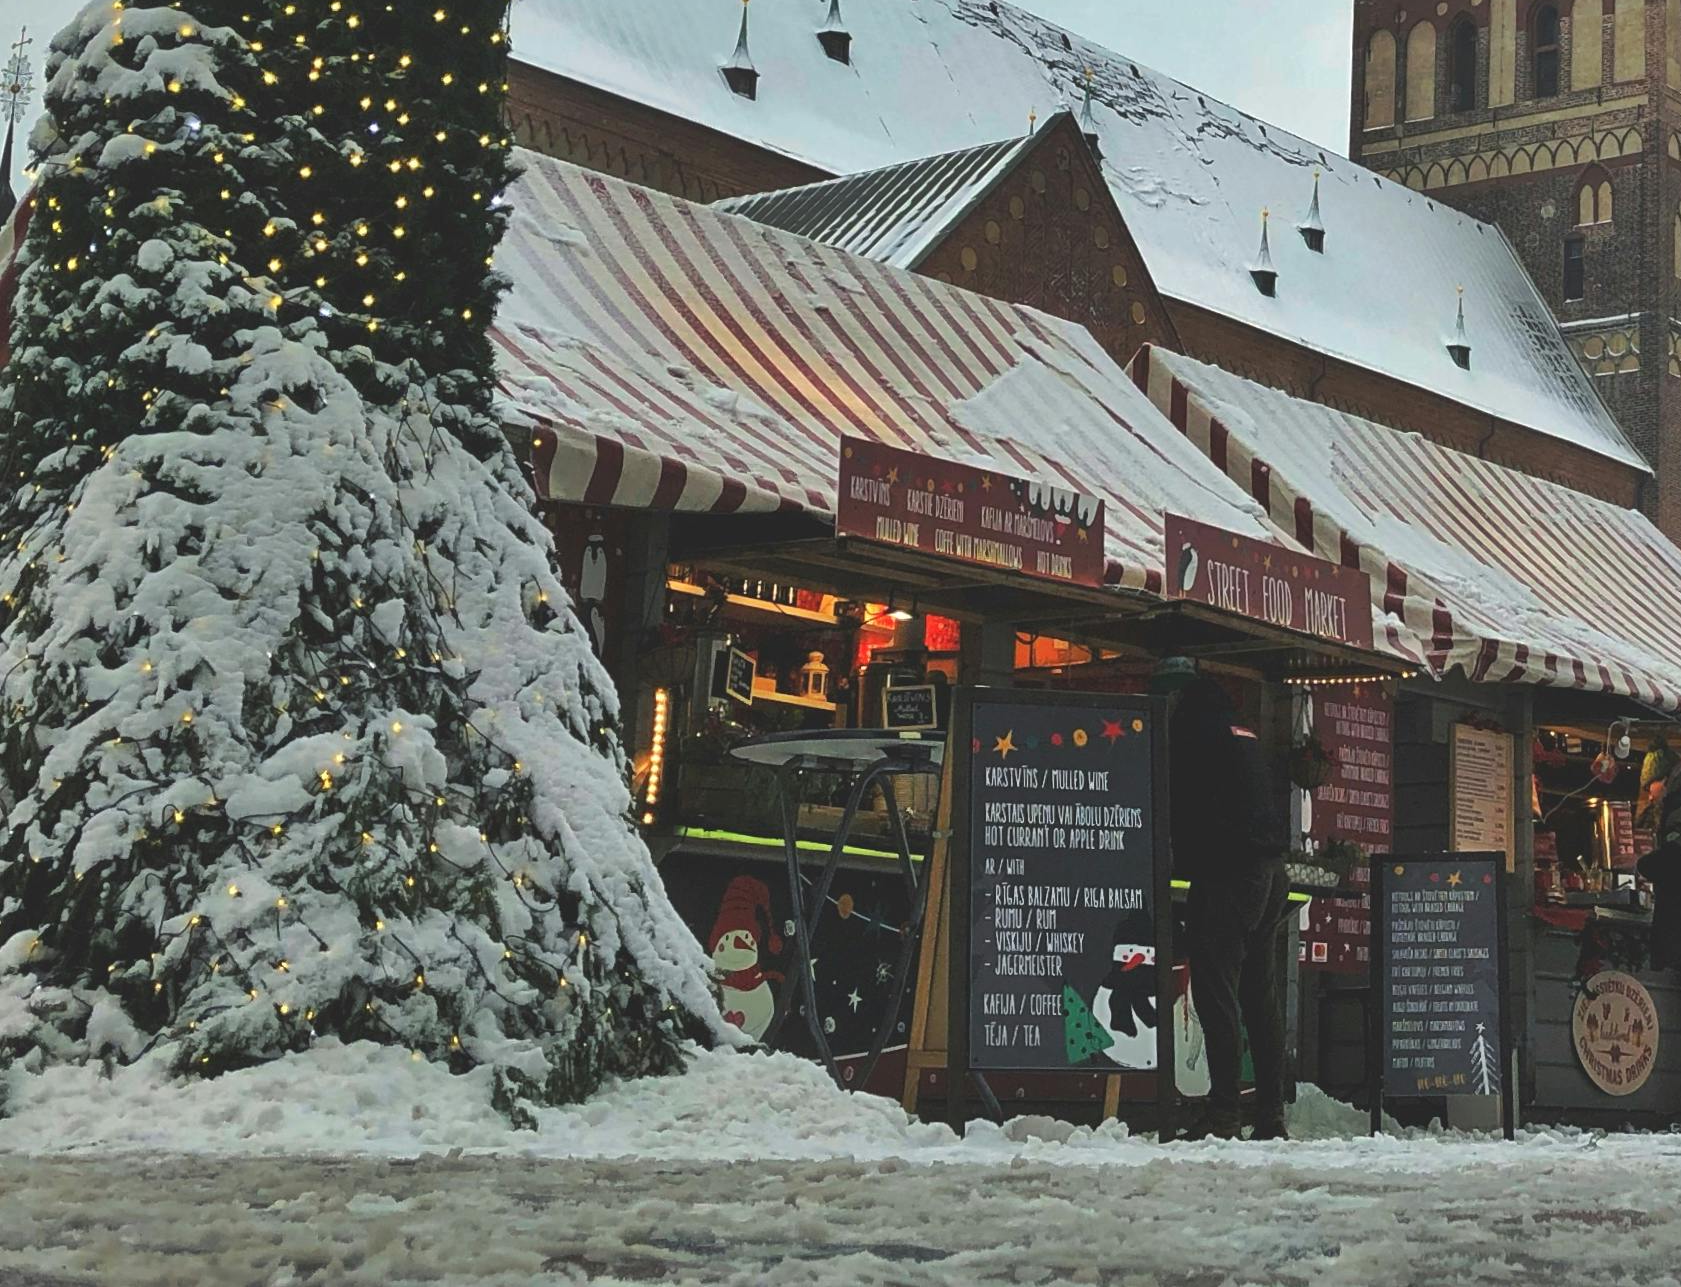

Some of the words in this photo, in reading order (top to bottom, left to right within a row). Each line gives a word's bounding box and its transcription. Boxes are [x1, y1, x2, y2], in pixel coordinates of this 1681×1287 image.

[876, 516, 901, 542] MULLED
[903, 522, 919, 548] WINE
[1004, 511, 1012, 532] AR
[956, 534, 972, 558] WITH
[1037, 550, 1050, 573] HOT
[1052, 553, 1072, 579] DRINKS
[1207, 560, 1249, 616] STREET
[1263, 576, 1292, 627] FOOD
[1305, 587, 1346, 640] MARKET
[985, 765, 1038, 789] KARSTVĪNS
[1051, 769, 1085, 790] MULLED
[1088, 771, 1109, 791] WINE
[985, 803, 1024, 824] KARSTAIS
[1058, 804, 1072, 825] VAI
[985, 826, 1003, 846] HOT
[1007, 826, 1049, 847] CURRANT
[1053, 828, 1066, 848] OR
[1069, 829, 1095, 850] APPLE
[1099, 830, 1125, 850] DRINK
[985, 858, 995, 874] AR
[1007, 858, 1024, 875] WITH
[996, 882, 1024, 906] RĪGAS
[1028, 885, 1070, 907] BALZAMU
[1084, 887, 1105, 907] RIGA
[1108, 888, 1142, 909] BALSAM
[995, 908, 1022, 929] RUMU
[1037, 909, 1056, 929] RUM
[996, 931, 1031, 952] VISKIJU
[1046, 932, 1084, 953] WHISKEY
[995, 954, 1062, 976] JAGERMEISTER
[984, 993, 1015, 1015] KAFIJA
[1030, 994, 1062, 1015] COFFEE
[985, 1022, 1007, 1046] TĒJA
[1024, 1024, 1040, 1046] TEA
[1580, 1036, 1622, 1085] CHRISTMAS
[1626, 1045, 1652, 1083] DRINKS
